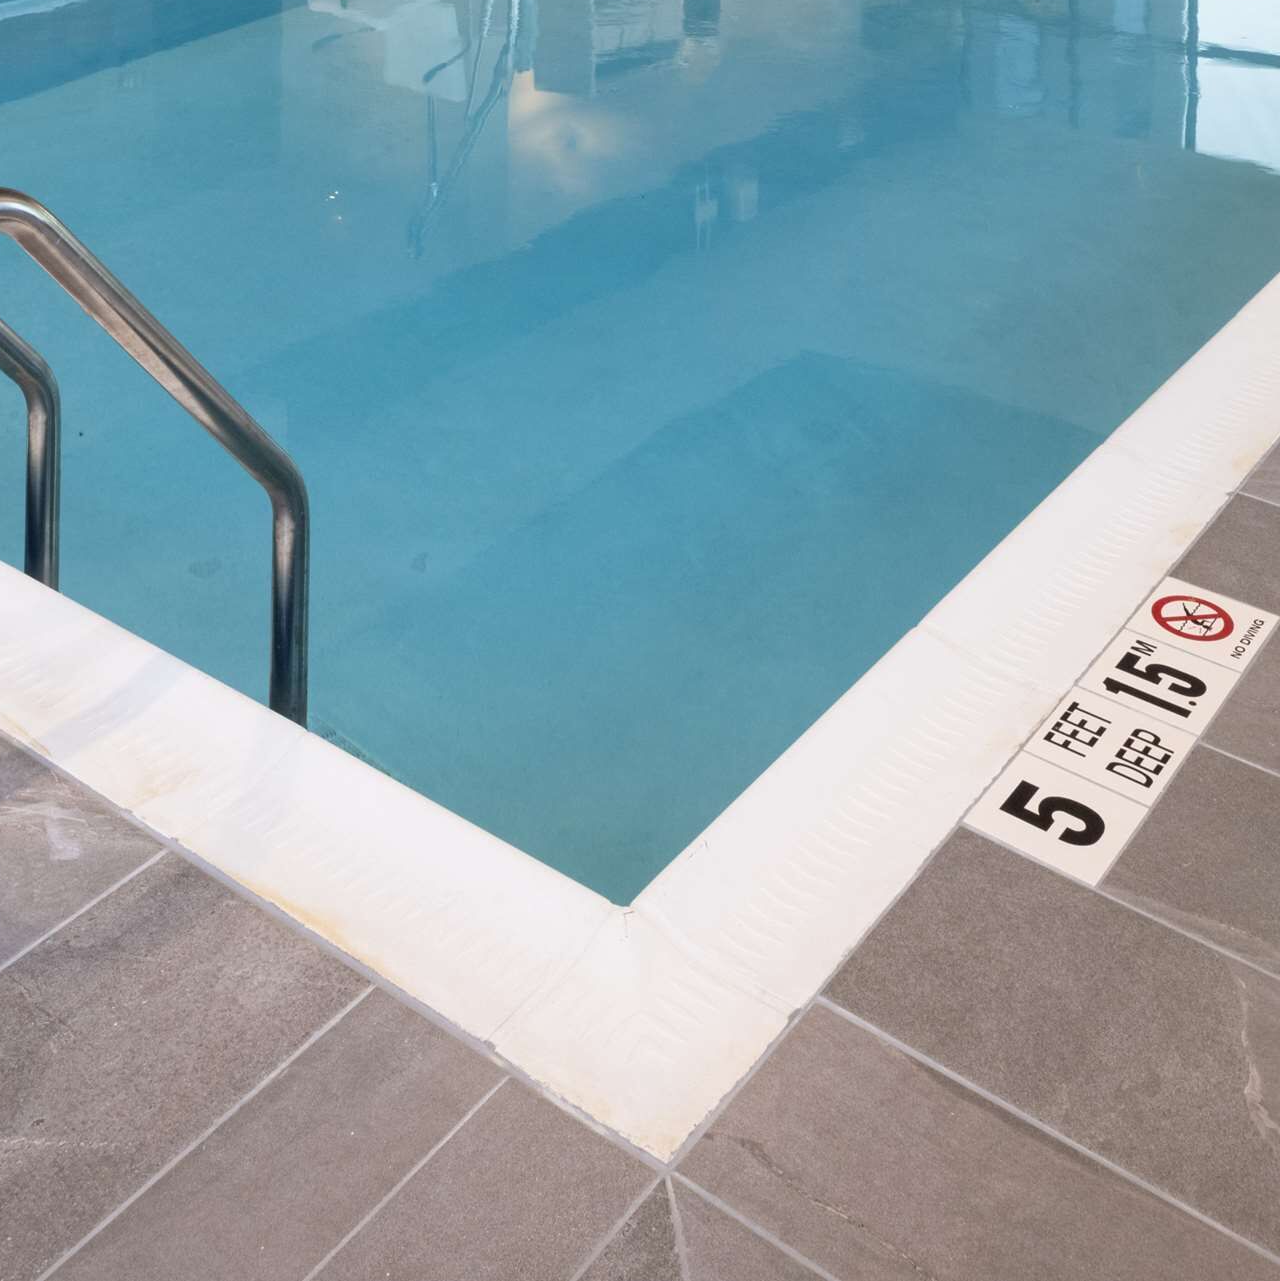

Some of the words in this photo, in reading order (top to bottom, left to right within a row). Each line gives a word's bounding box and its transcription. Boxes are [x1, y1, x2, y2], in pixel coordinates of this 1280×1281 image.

[1230, 643, 1247, 660] NO
[1240, 618, 1265, 648] DIVING
[1042, 701, 1112, 758] FEET
[1104, 727, 1175, 788] DEEP
[999, 779, 1107, 847] 5
